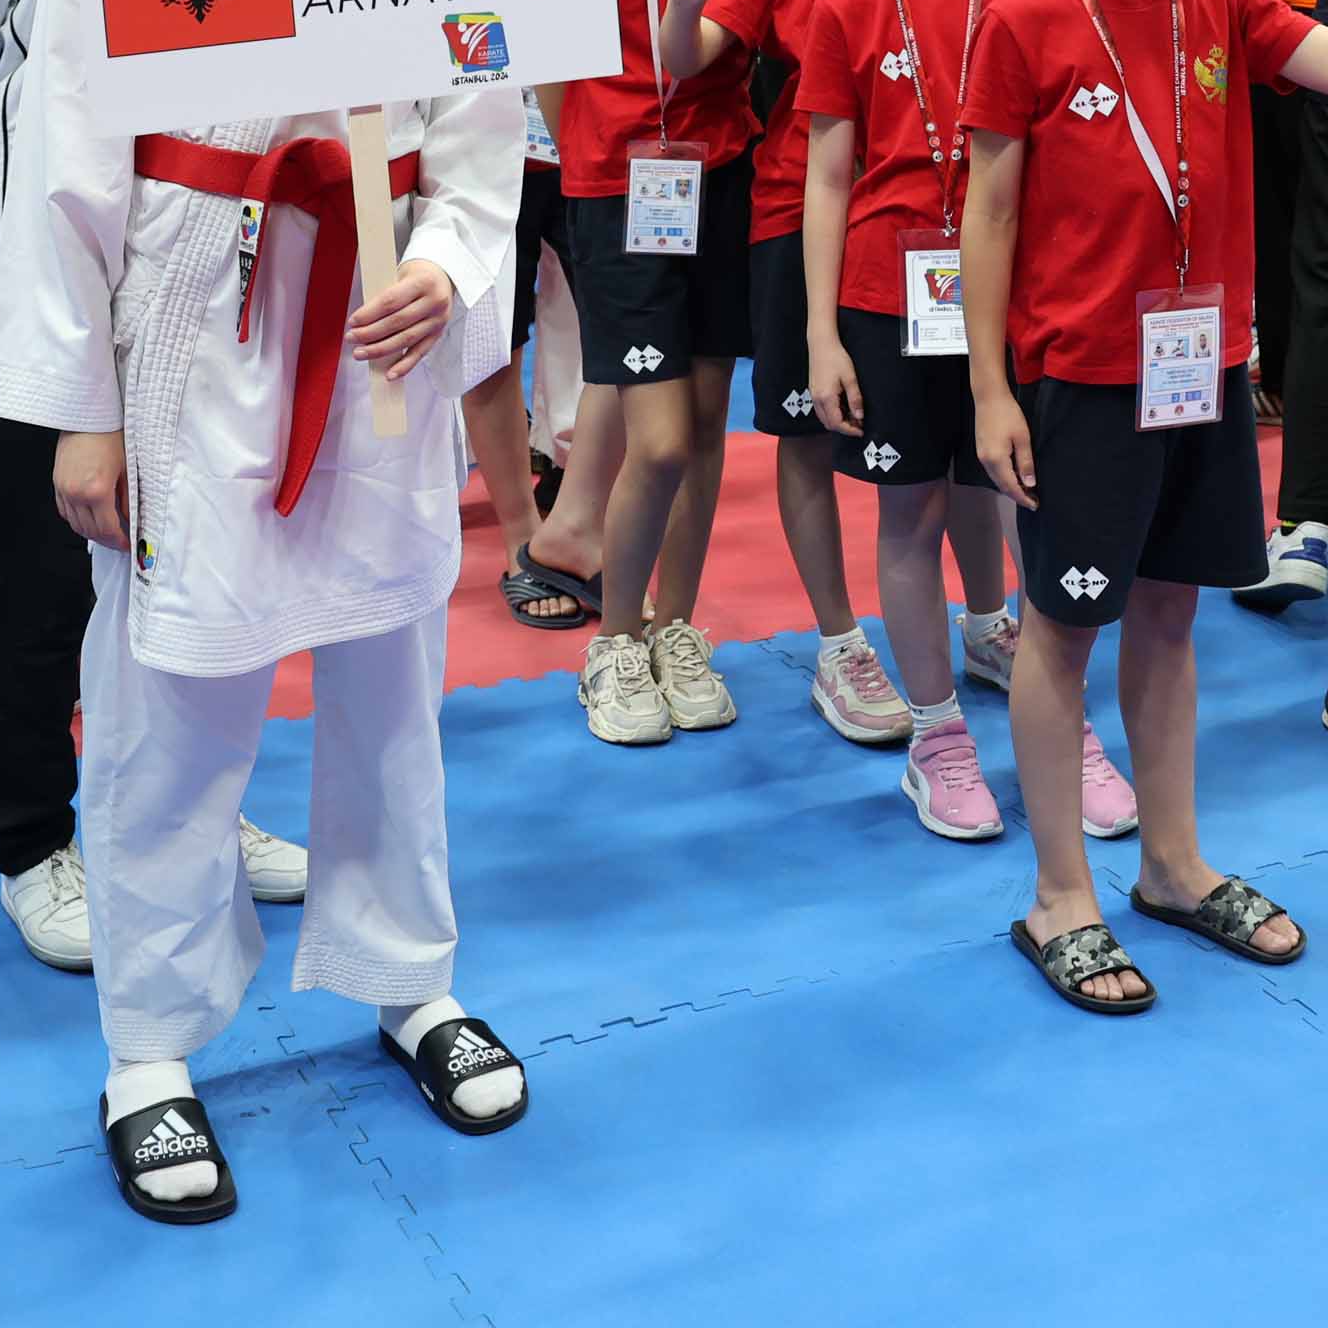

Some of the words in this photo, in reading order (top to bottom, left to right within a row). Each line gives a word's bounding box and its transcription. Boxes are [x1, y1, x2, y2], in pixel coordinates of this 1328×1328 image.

[451, 74, 489, 87] ISTANBUL
[490, 72, 509, 82] 2024
[447, 1046, 507, 1072] adidas
[134, 1134, 209, 1159] adidas
